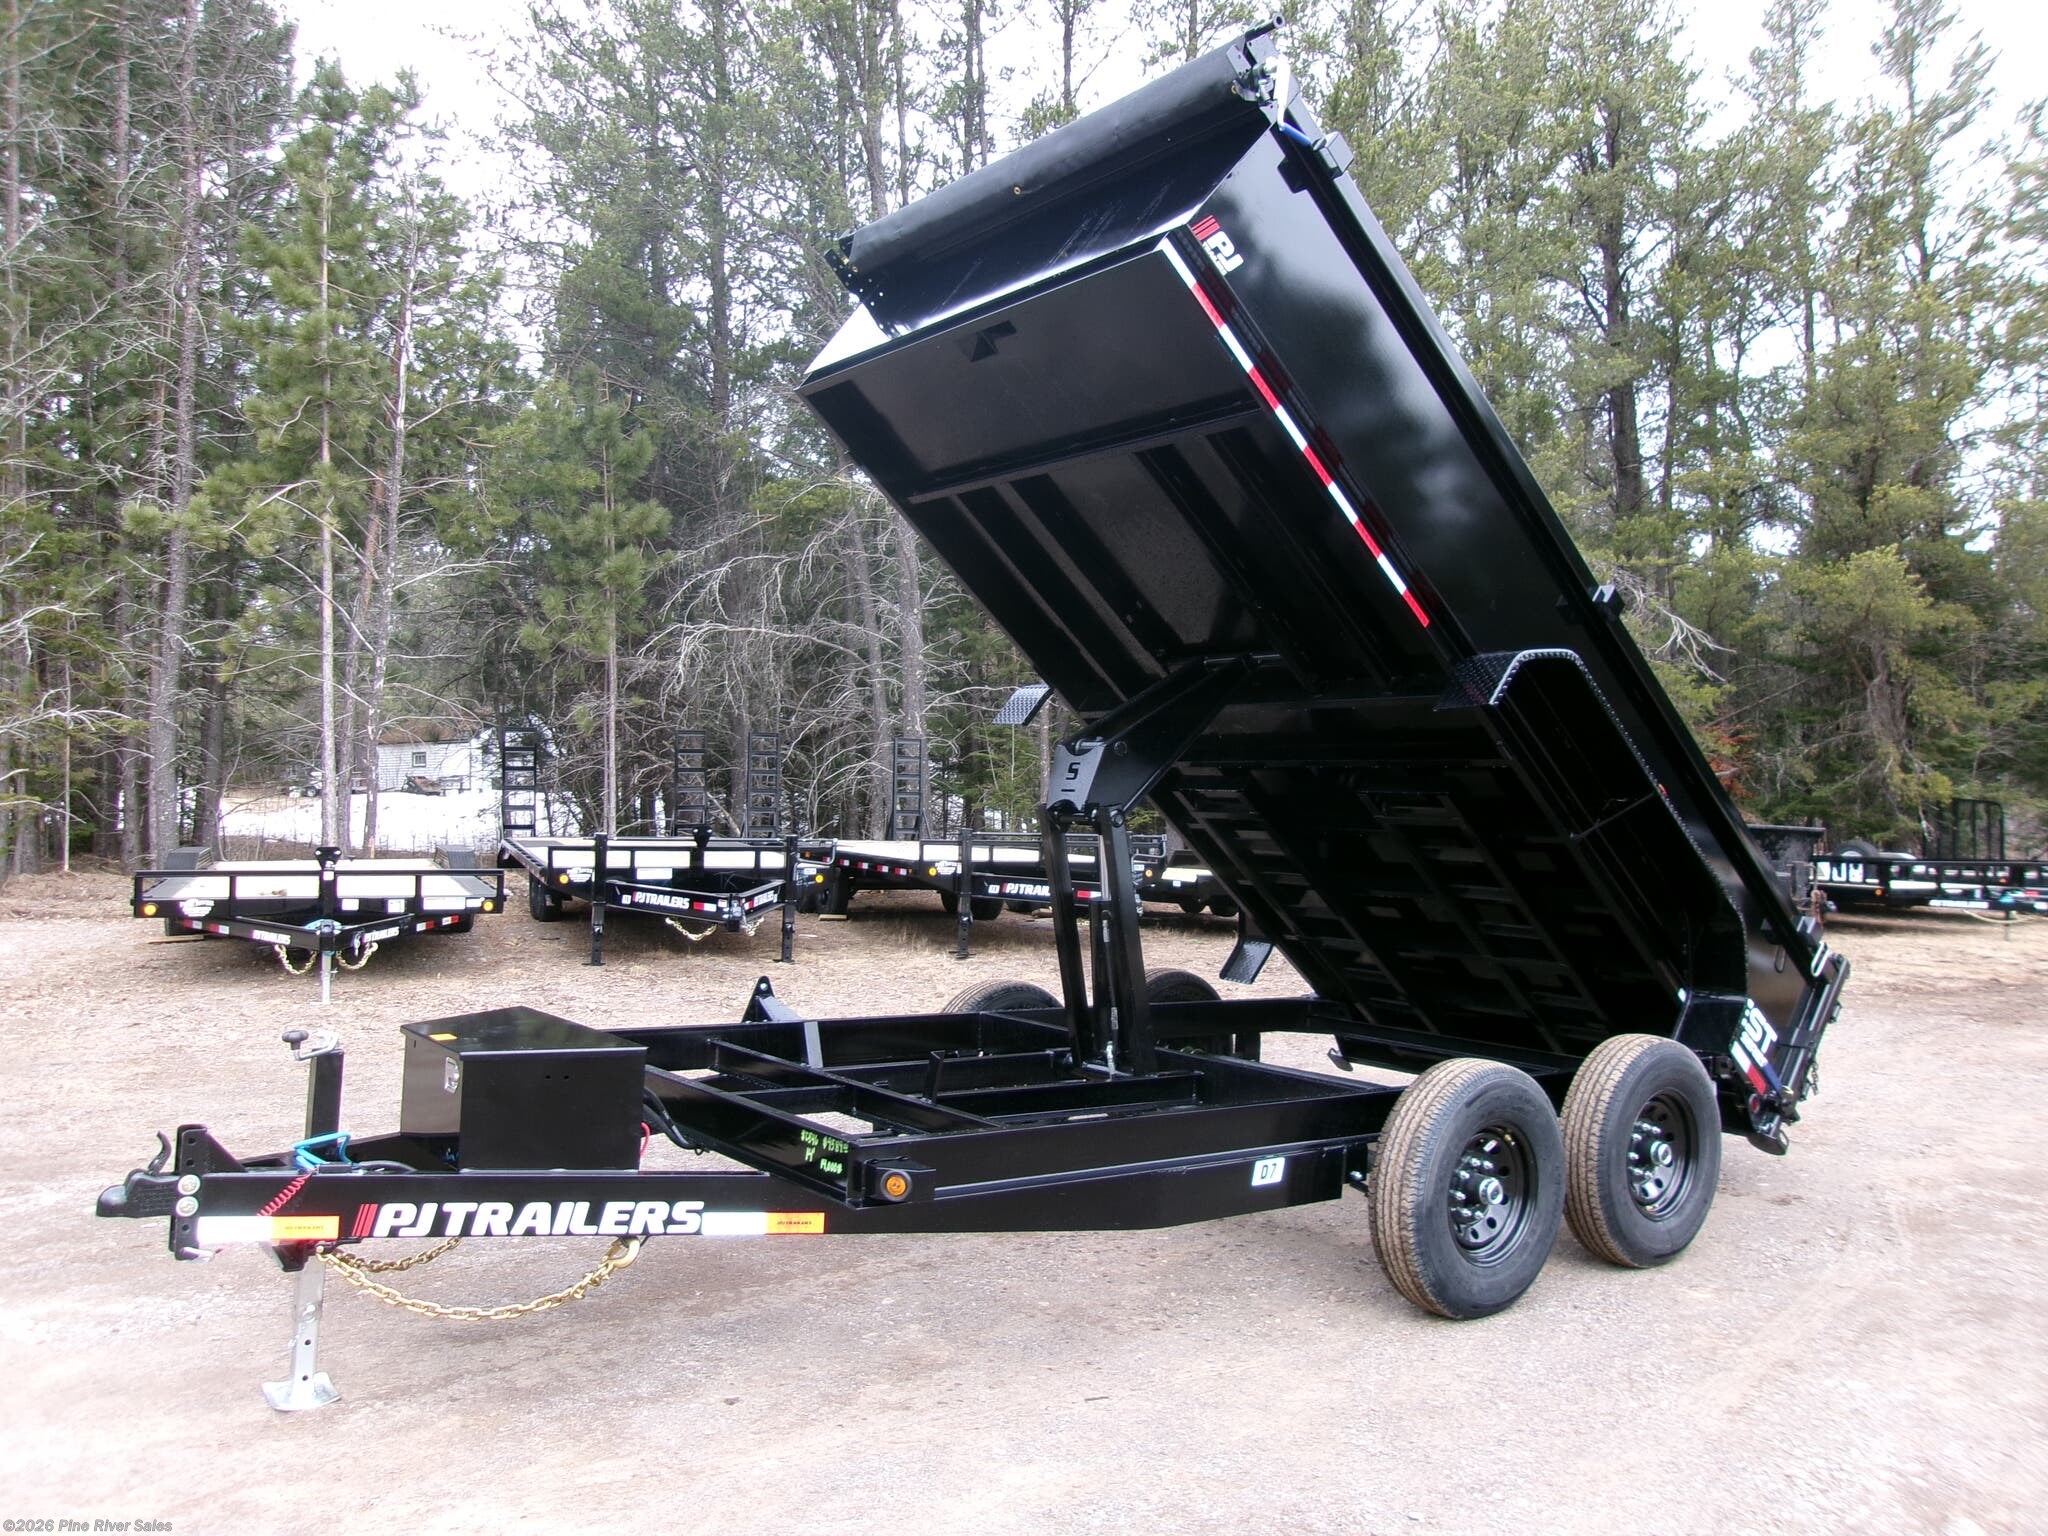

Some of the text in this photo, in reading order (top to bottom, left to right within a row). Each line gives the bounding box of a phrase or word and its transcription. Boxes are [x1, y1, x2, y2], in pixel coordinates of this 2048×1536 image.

[1205, 231, 1244, 273] PJ
[373, 1201, 705, 1237] PJ TRAILERS
